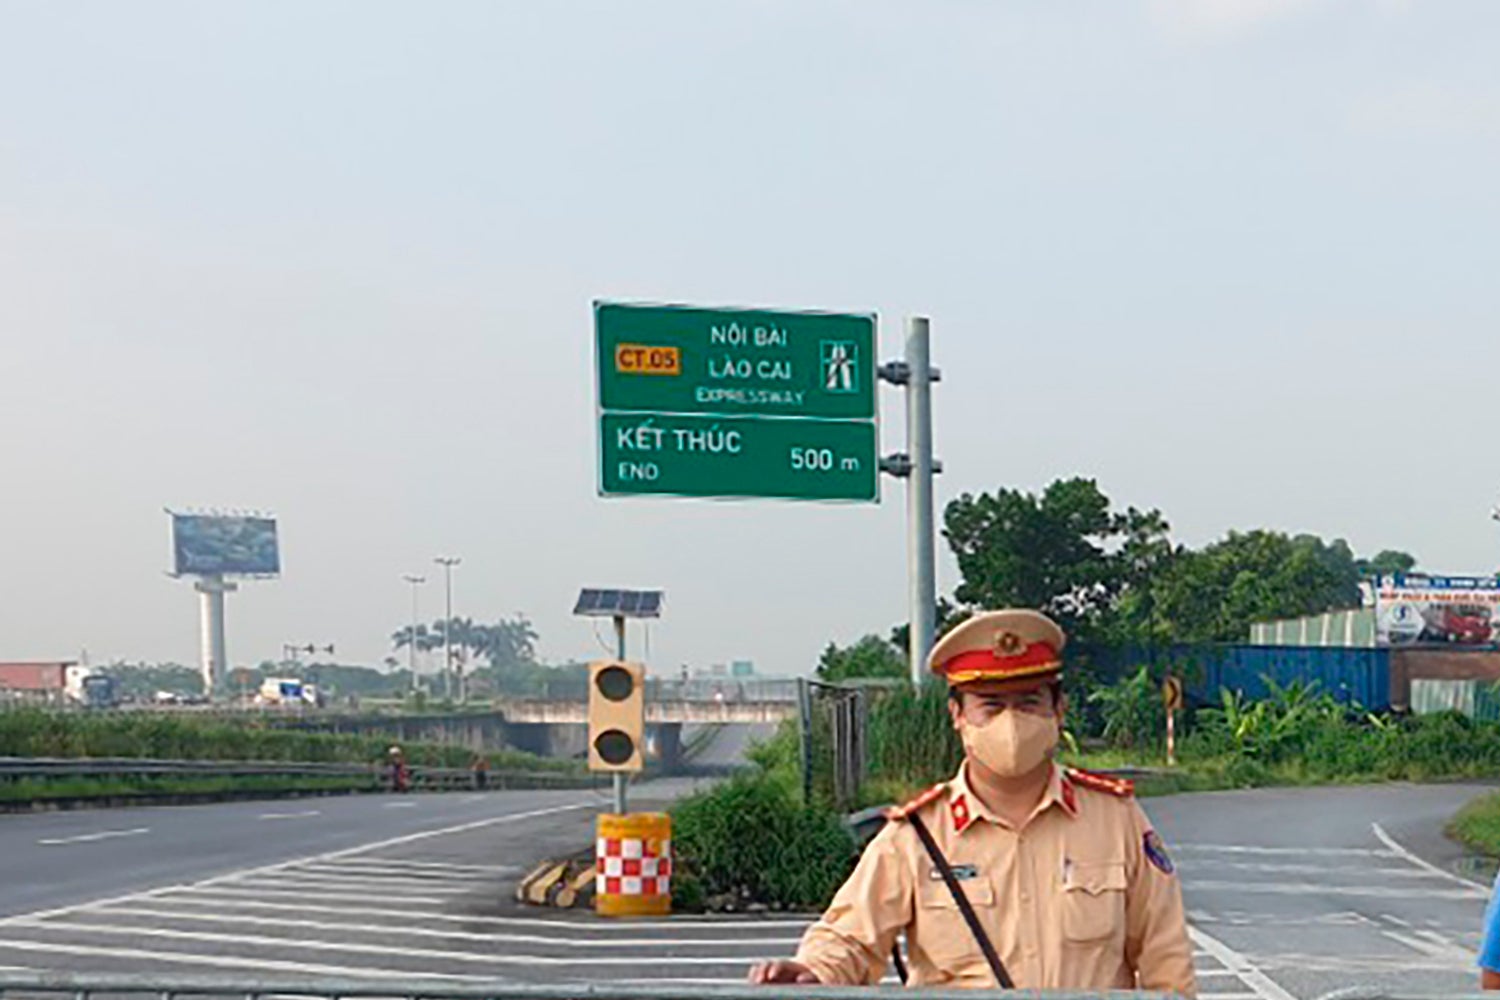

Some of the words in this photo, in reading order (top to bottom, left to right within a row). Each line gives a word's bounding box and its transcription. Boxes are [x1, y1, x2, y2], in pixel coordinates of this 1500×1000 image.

[710, 322, 747, 348] NỘI
[754, 323, 787, 346] BÀI
[619, 348, 675, 369] CT.05
[708, 353, 752, 378] LÀO
[757, 360, 791, 379] CAI
[617, 418, 665, 451] KẾT
[672, 423, 742, 453] THÚC
[618, 462, 659, 480] END
[791, 447, 833, 470] 500
[841, 457, 860, 471] m
